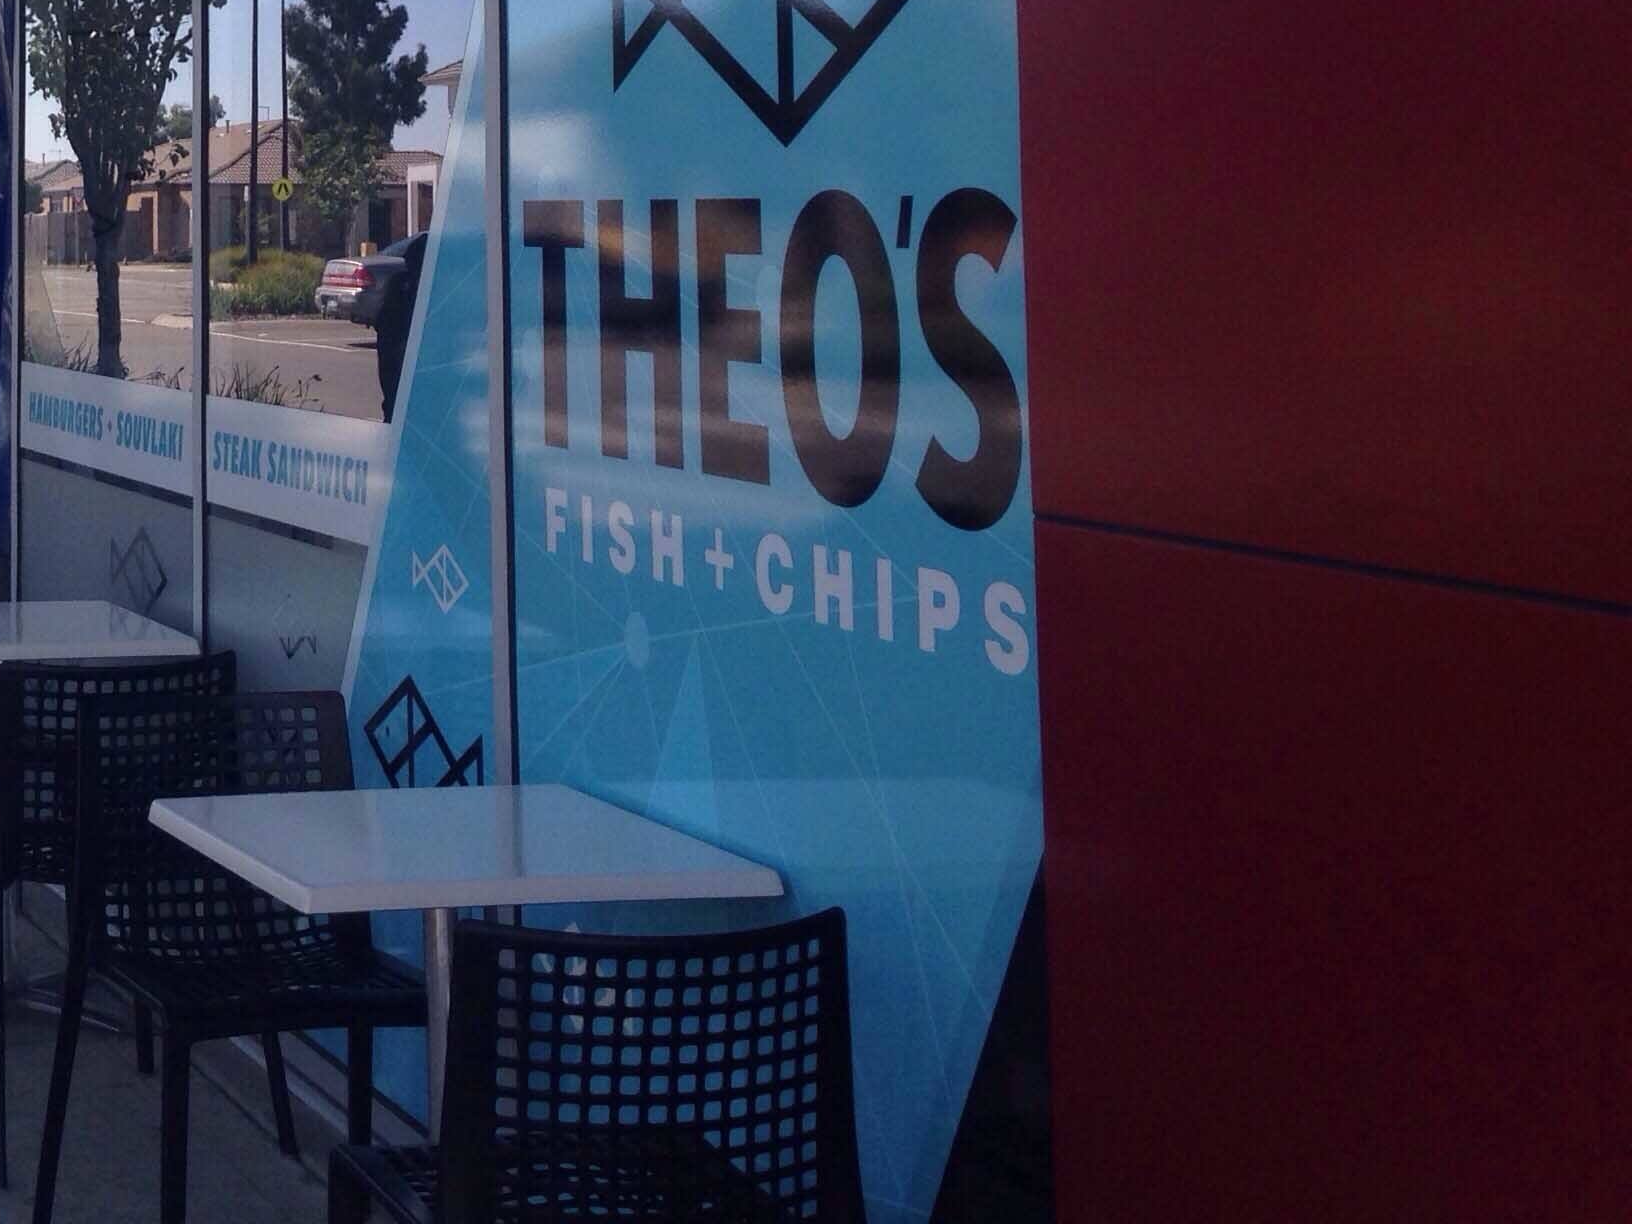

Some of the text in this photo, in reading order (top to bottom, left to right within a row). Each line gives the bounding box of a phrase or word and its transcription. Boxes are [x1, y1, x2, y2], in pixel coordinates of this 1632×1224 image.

[523, 187, 1022, 531] THEO'S
[29, 391, 184, 461] HAMBURGERS SOUVLAKI
[213, 431, 367, 505] STEAK SANDWICH
